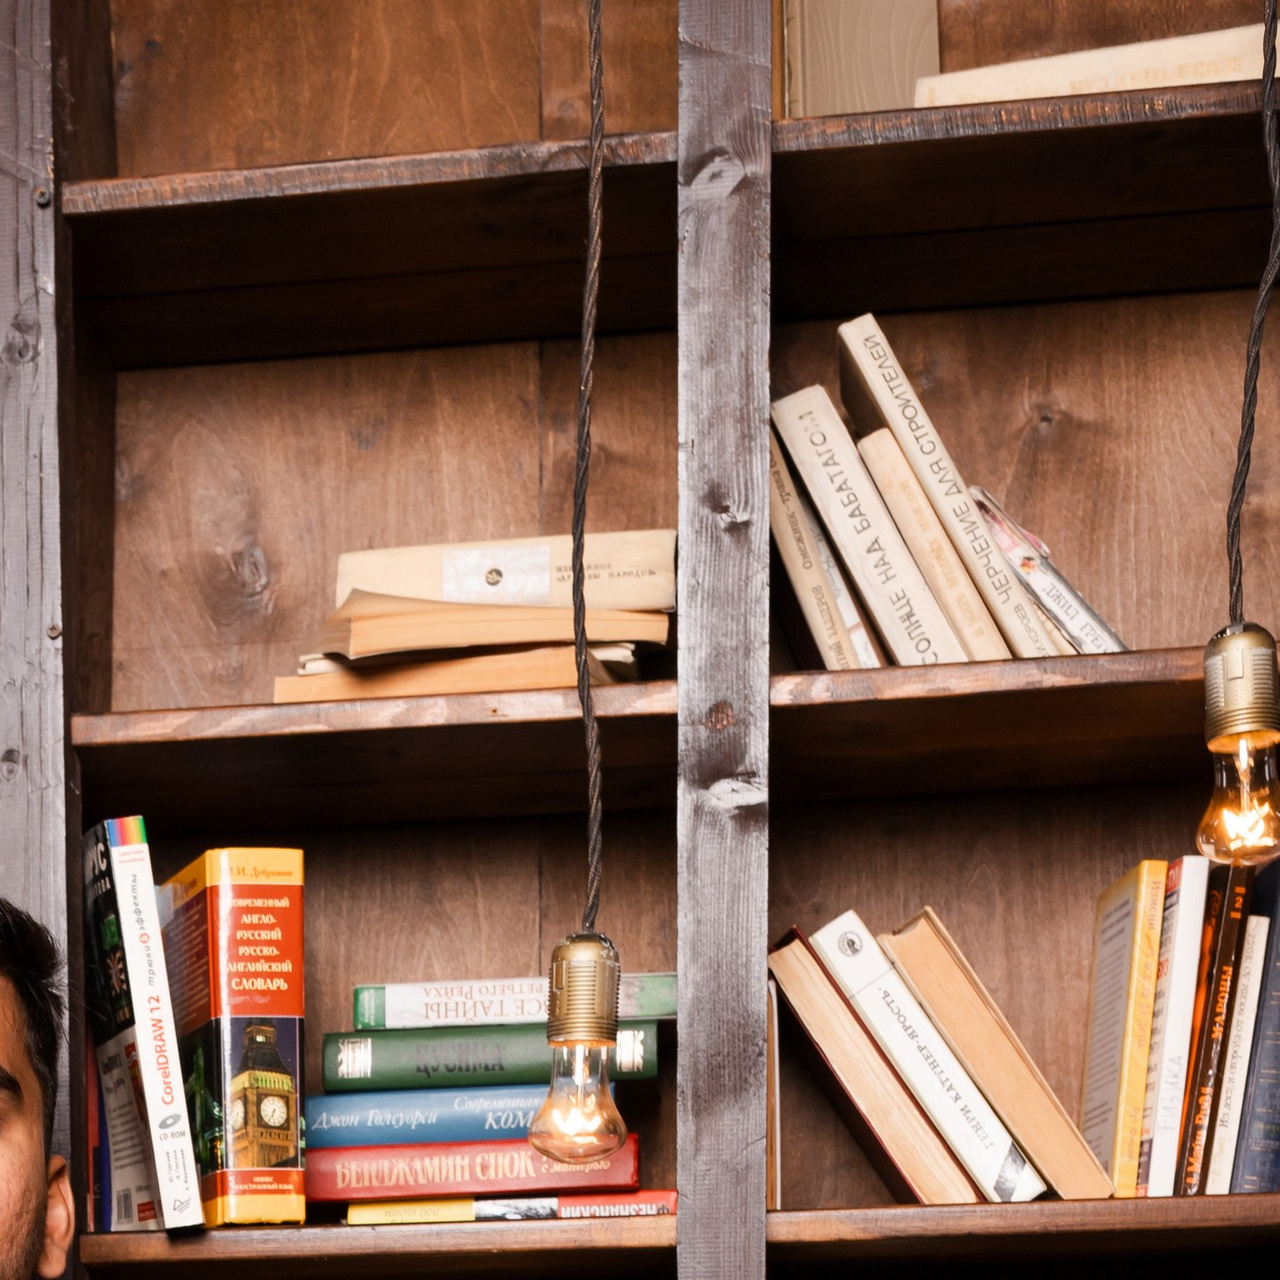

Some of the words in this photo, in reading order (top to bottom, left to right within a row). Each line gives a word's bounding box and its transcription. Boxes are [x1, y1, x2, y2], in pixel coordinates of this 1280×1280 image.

[864, 335, 939, 455] СТРОИТЕЛЕЙ
[930, 457, 963, 497] ДЛЯ
[867, 536, 897, 585] НАД
[953, 503, 1013, 605] ЧЕРЧЕНИЕ
[890, 587, 939, 666] СОЛНЦЕ
[1012, 602, 1041, 641] КОРОЕВ
[131, 873, 145, 931] эффекты
[240, 914, 277, 924] АНГЛО-
[1146, 879, 1161, 932] Измени
[1234, 896, 1243, 908] 2
[236, 926, 282, 941] РУССКИЙ
[238, 946, 280, 957] РУССКО-
[145, 944, 157, 987] трюки
[227, 961, 293, 973] АНГЛИЙСКИЙ
[231, 978, 288, 991] СЛОВАРЬ
[149, 994, 161, 1013] 12
[424, 998, 507, 1020] ТАЙНЫ
[1212, 964, 1233, 1041] МАРОНЫ
[150, 1020, 175, 1106] CorelDRAW
[415, 1041, 505, 1078] ЦУСИМА
[158, 1129, 187, 1142] CD-ROM
[312, 1110, 360, 1131] Джон
[366, 1108, 439, 1129] Голсуорси
[336, 1152, 470, 1189] БЕНДЖАМИН
[475, 1150, 536, 1181] СПОК
